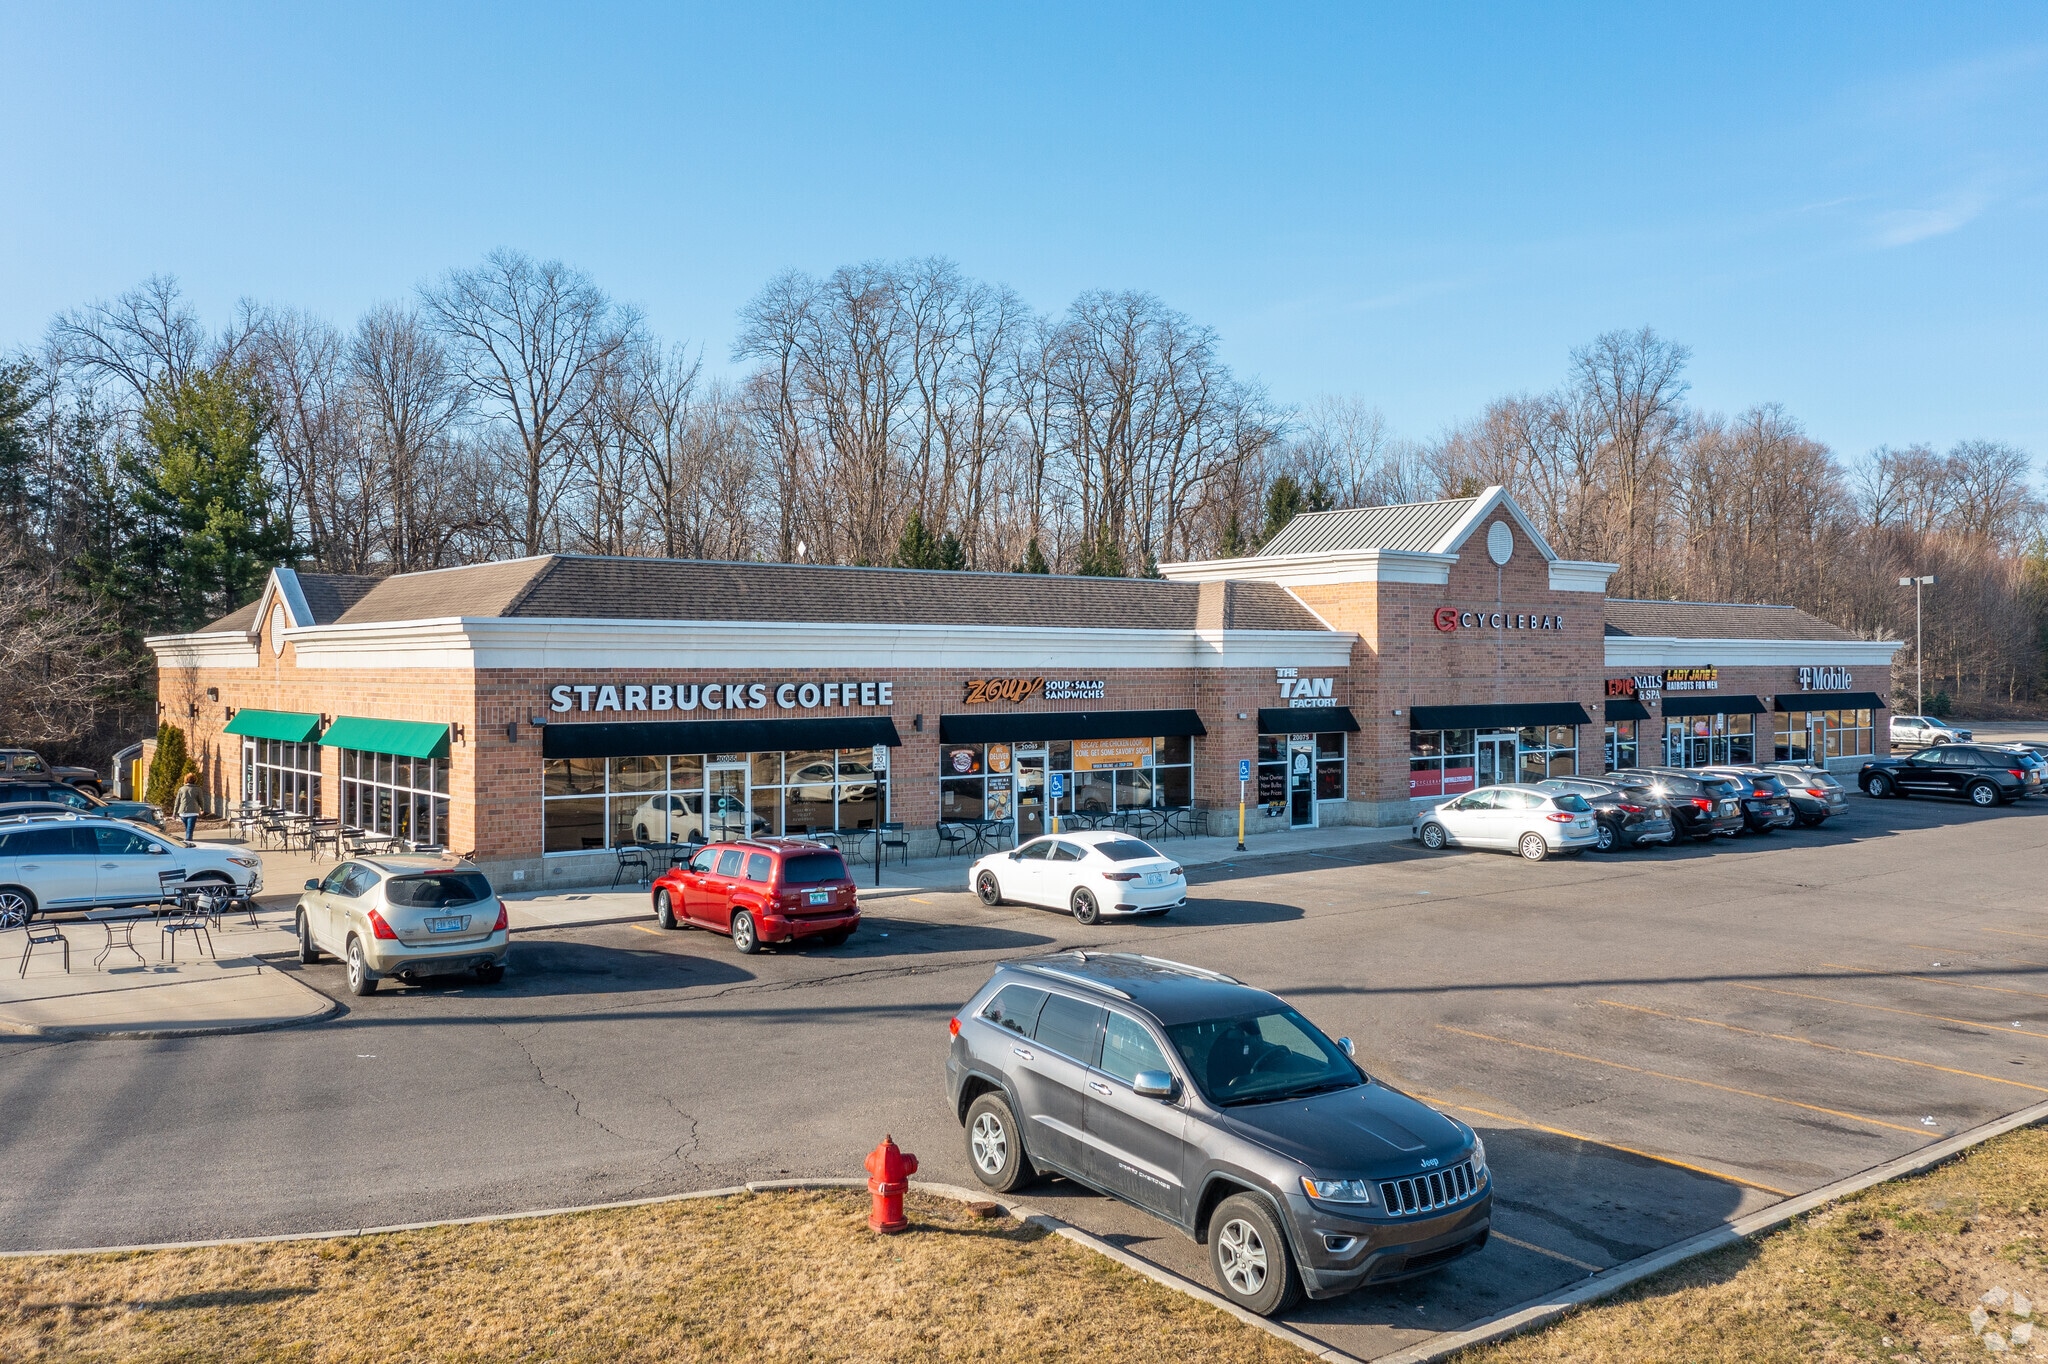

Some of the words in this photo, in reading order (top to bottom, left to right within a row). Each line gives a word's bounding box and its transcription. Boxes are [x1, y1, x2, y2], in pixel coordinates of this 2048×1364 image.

[1461, 612, 1563, 630] CYCLEBAR
[1276, 668, 1298, 677] THE
[1665, 669, 1690, 681] LADY
[1277, 678, 1333, 698] TAN
[1607, 678, 1635, 696] EPIC
[1634, 675, 1662, 689] NAILS
[1666, 681, 1695, 691] HAIRCUTS
[1695, 681, 1706, 690] FOR
[1706, 680, 1718, 689] MEN
[550, 683, 767, 712] STARBUCKS
[775, 682, 893, 709] COFFEE
[1045, 689, 1105, 700] SANDWICHES
[1639, 690, 1645, 700] &
[1646, 690, 1660, 700] SPA
[1289, 698, 1338, 708] FACTORY
[1080, 741, 1099, 749] ESCAPE
[989, 752, 1010, 760] DELIVER
[1075, 749, 1089, 757] COME
[1090, 749, 1100, 757] GET
[1100, 748, 1115, 756] SOME
[1115, 747, 1135, 755] SAVORY
[716, 754, 737, 762] 20055
[1420, 1158, 1439, 1168] Jeep
